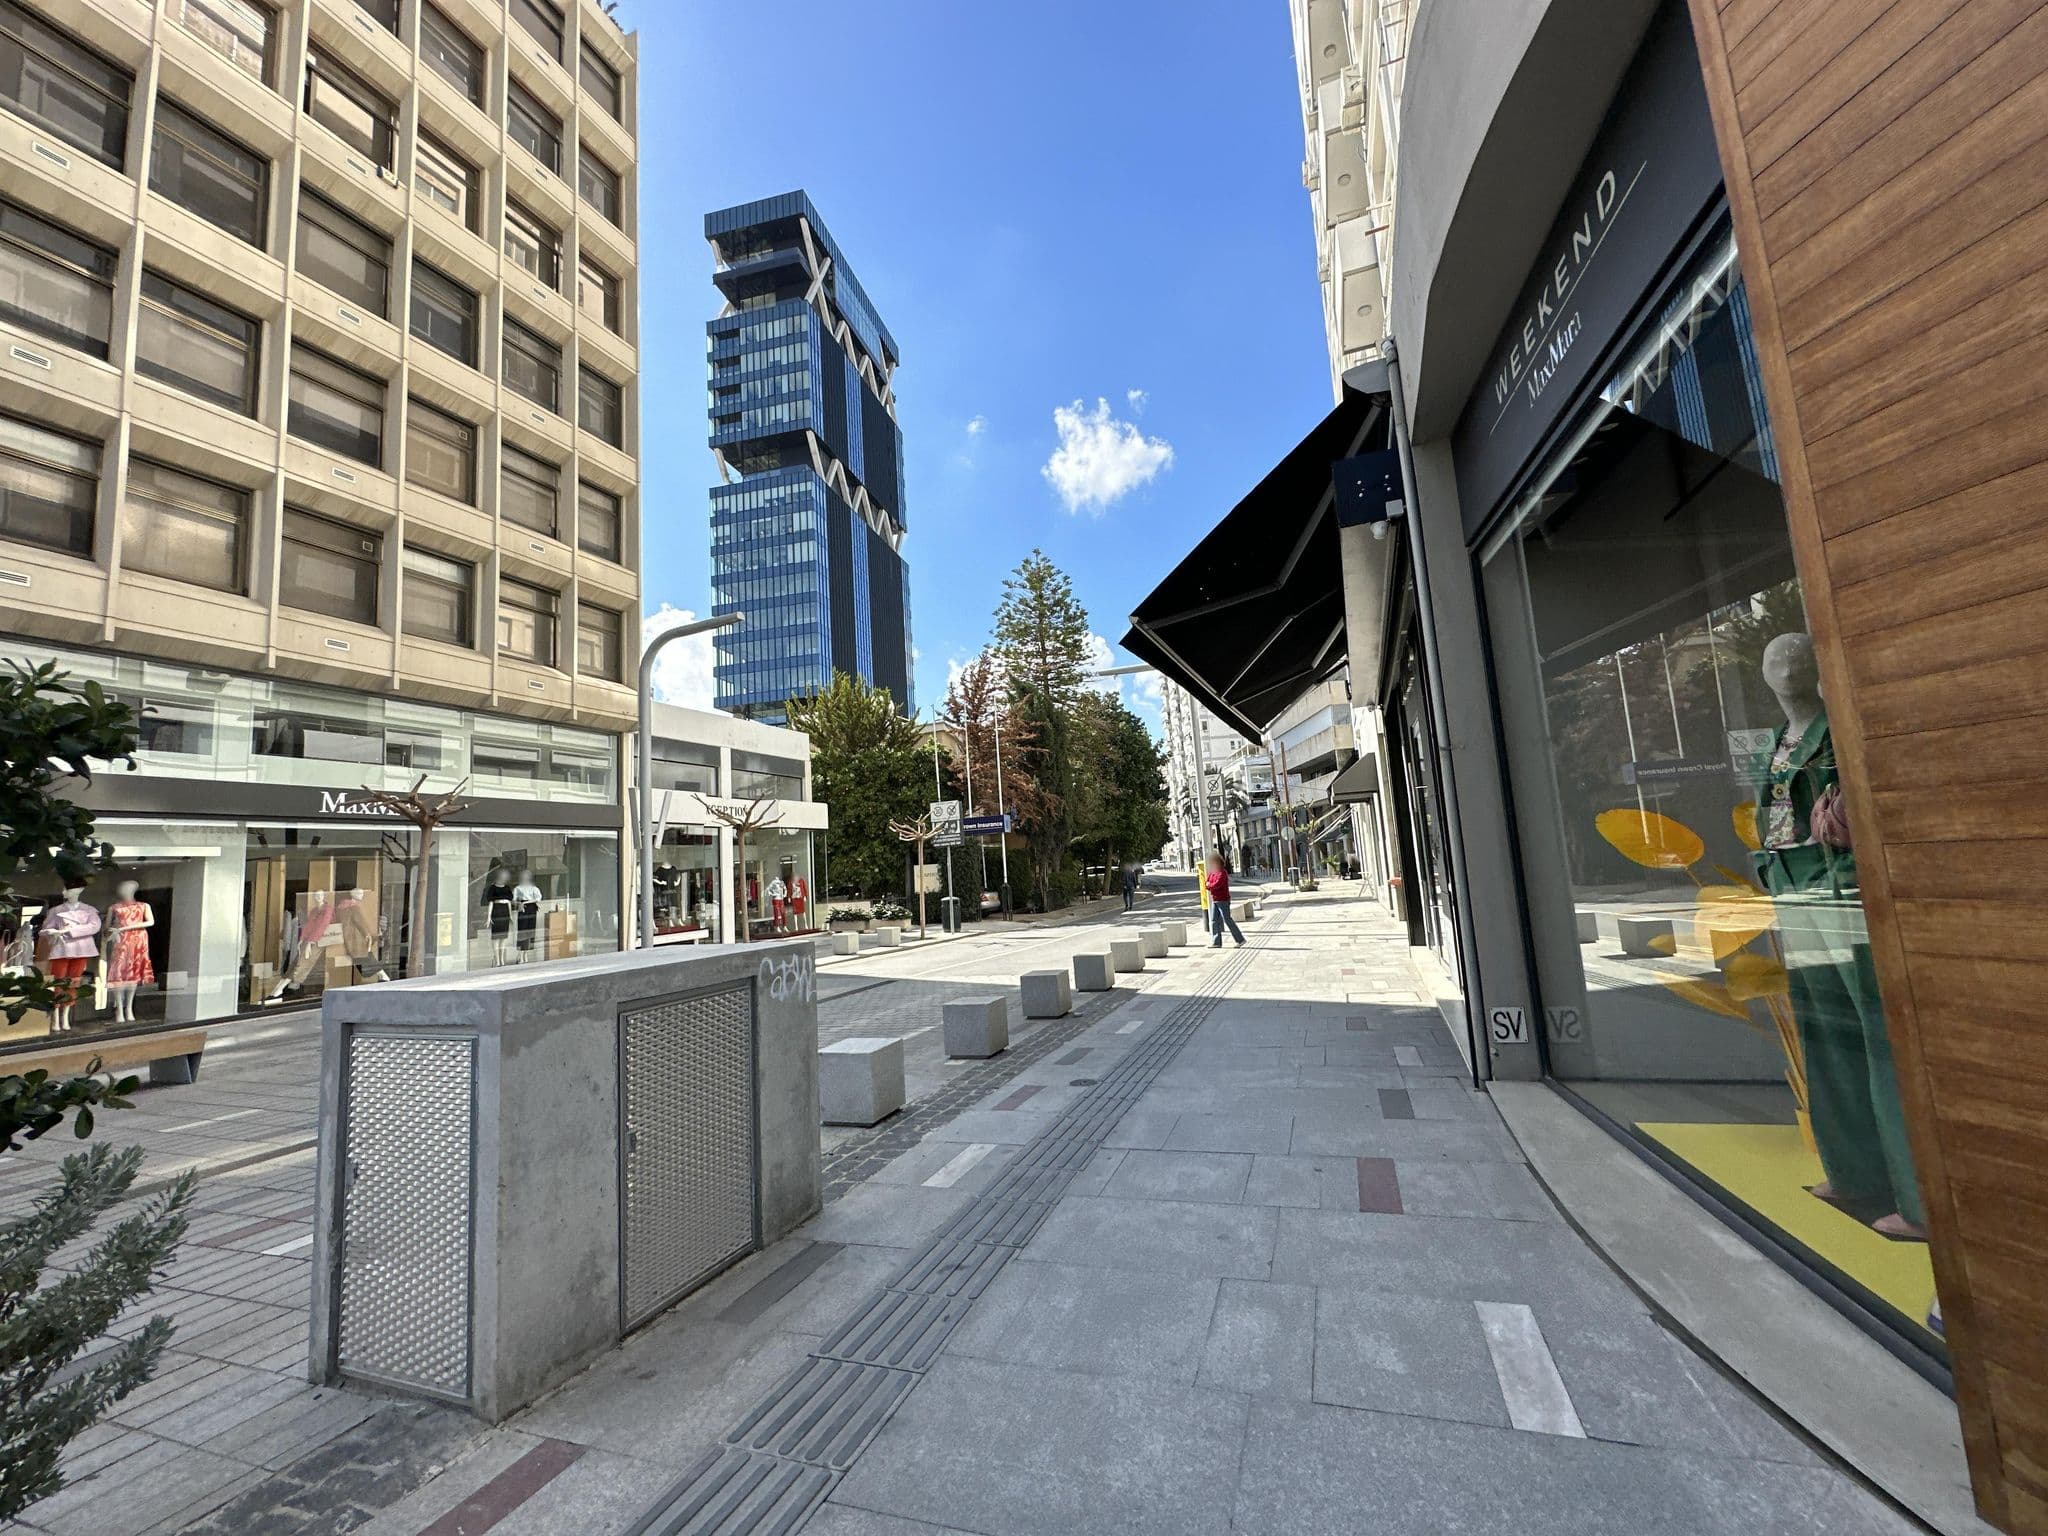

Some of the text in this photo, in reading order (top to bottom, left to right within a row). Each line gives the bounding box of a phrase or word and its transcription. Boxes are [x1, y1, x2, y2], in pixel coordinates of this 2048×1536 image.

[1495, 170, 1616, 404] WEEKEND
[1527, 312, 1582, 408] MaxMara
[1493, 1011, 1521, 1039] SV
